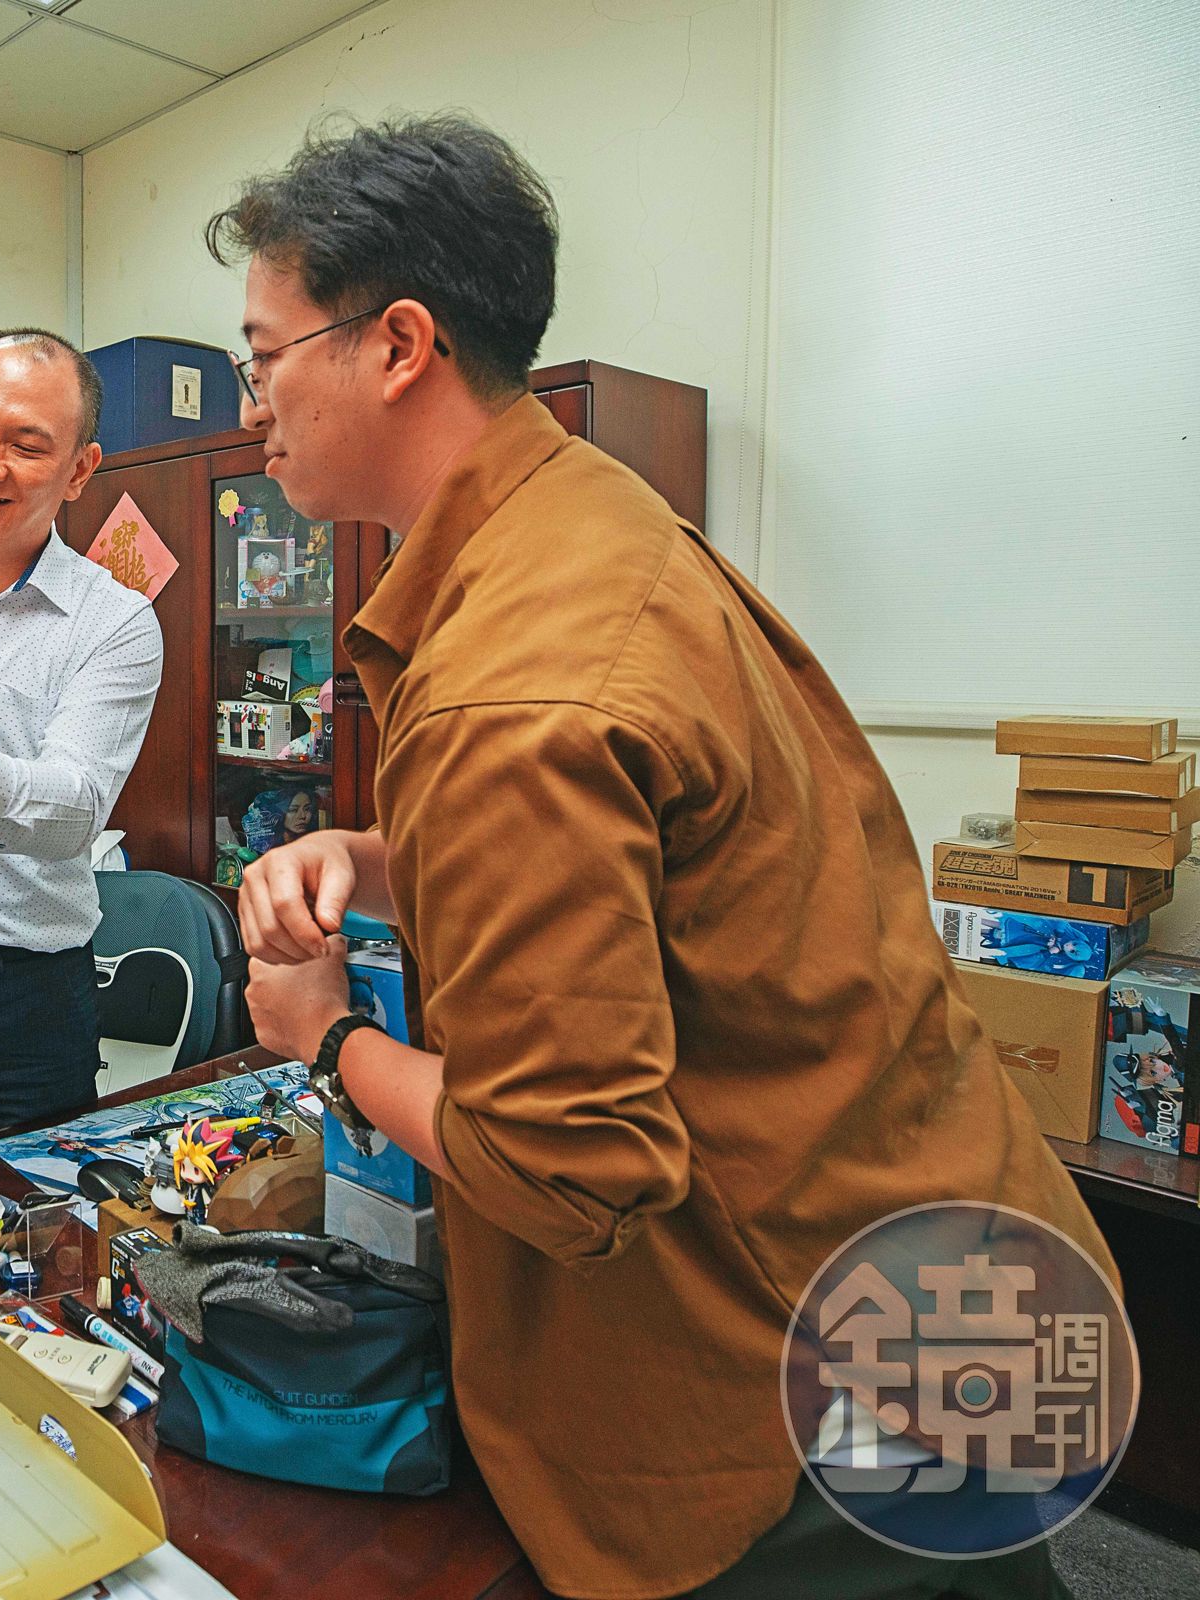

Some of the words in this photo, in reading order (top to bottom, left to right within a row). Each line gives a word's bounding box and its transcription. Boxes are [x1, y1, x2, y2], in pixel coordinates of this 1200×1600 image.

[1145, 1100, 1178, 1147] figma
[223, 1377, 245, 1398] THE
[317, 1410, 378, 1426] MERCURY
